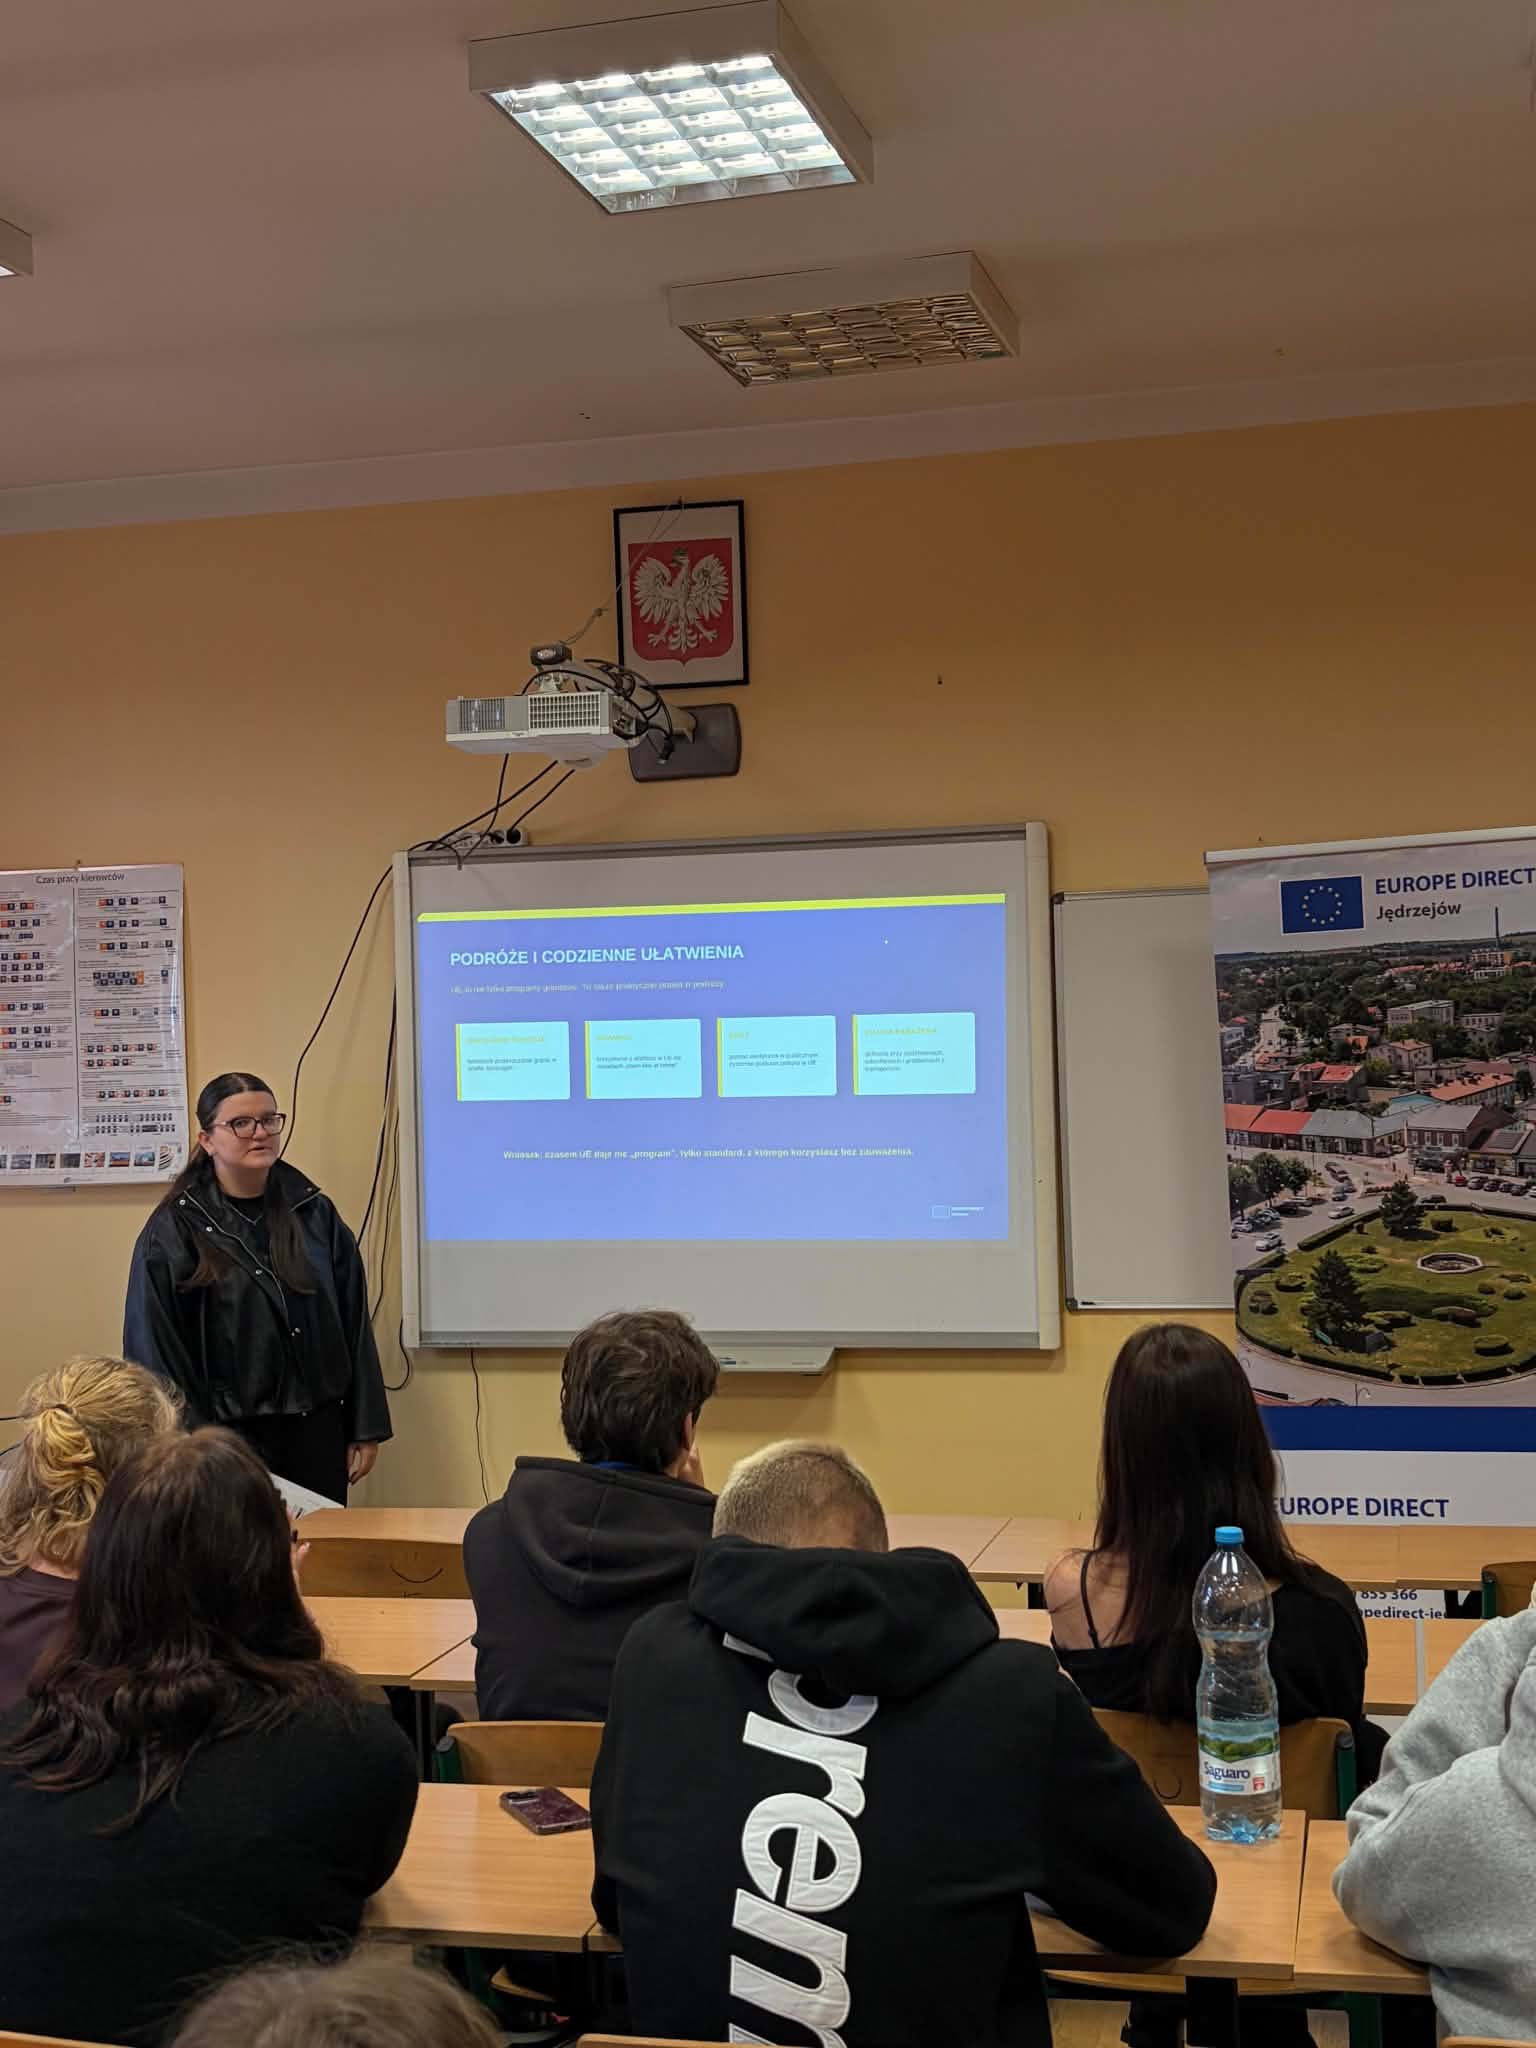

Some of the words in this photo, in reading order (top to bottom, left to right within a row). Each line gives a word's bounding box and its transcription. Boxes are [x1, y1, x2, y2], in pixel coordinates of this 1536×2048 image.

[1375, 873, 1457, 895] EUROPE
[1462, 867, 1536, 889] DIRECT
[1376, 901, 1462, 922] Jędrzejów
[450, 948, 529, 966] PODRÓŻE
[533, 951, 537, 964] I
[542, 948, 637, 964] CODZIENNE
[641, 944, 744, 961] UŁATWIENIA
[1365, 1498, 1449, 1518] DIRECT
[1359, 1605, 1448, 1619] pedirect-ie
[1204, 1761, 1251, 1781] Saguaro
